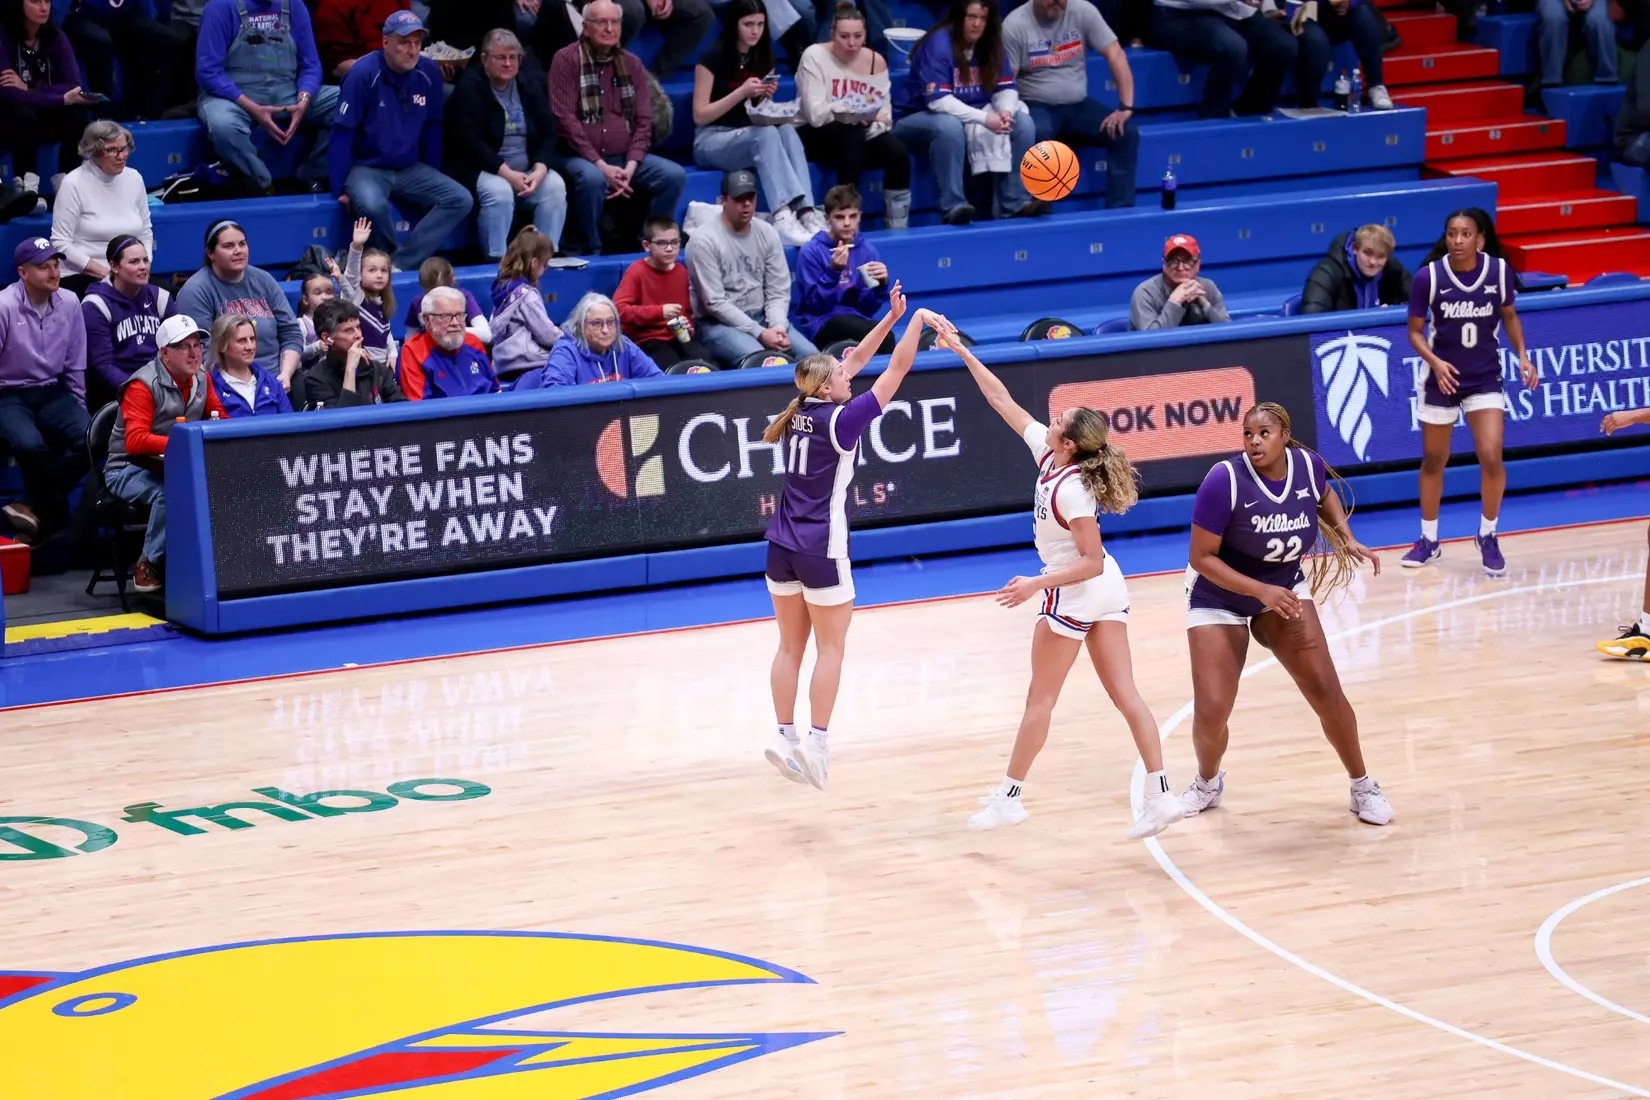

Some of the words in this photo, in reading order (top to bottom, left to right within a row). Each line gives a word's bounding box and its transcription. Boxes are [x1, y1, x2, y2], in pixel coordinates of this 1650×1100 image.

[413, 94, 426, 106] KU
[1440, 301, 1494, 318] Wildcats
[1461, 322, 1478, 348] 0
[791, 413, 813, 433] SIDES
[1096, 404, 1156, 434] OK
[1164, 396, 1242, 428] NOW
[678, 397, 961, 483] CHICE
[788, 434, 810, 476] 11
[279, 444, 423, 488] WHERE
[435, 433, 535, 472] FANS
[296, 485, 393, 525] STAY
[405, 472, 524, 513] WHEN
[266, 519, 428, 565] THEY'RE
[441, 506, 557, 546] AWAY
[1251, 510, 1311, 533] Wildcats
[1263, 535, 1302, 563] 22
